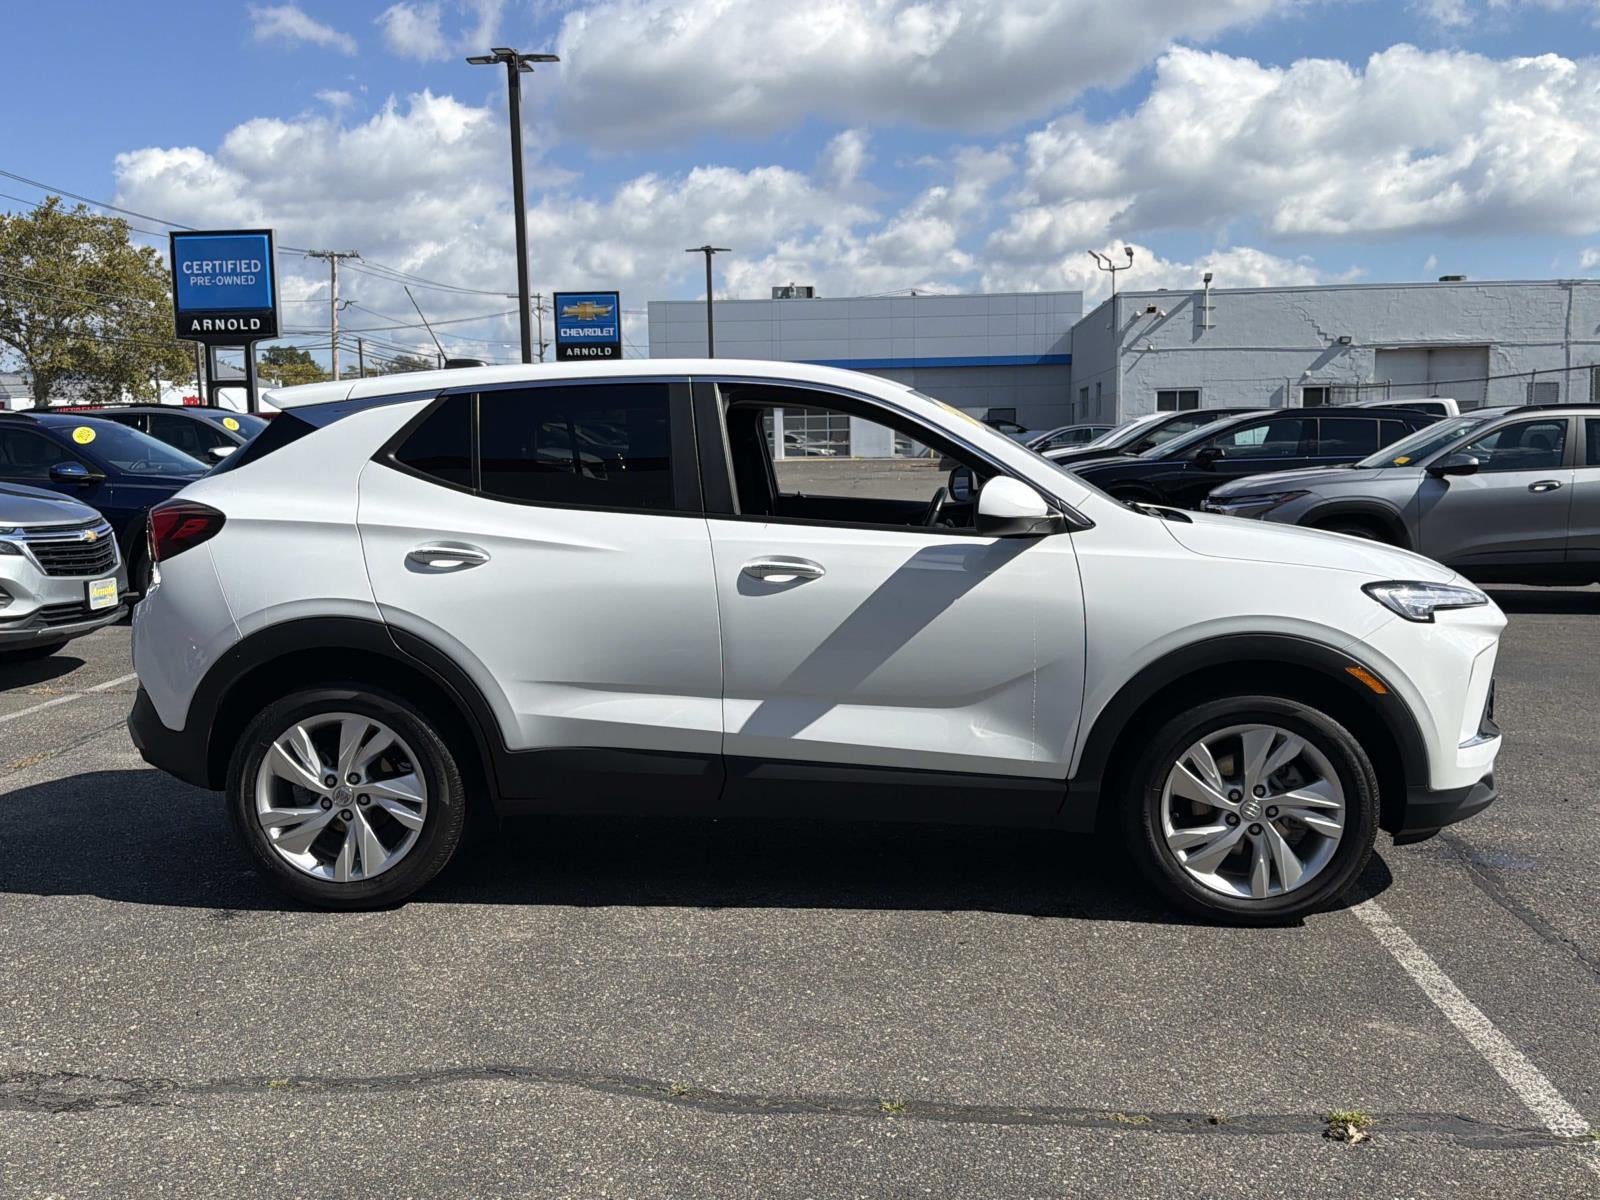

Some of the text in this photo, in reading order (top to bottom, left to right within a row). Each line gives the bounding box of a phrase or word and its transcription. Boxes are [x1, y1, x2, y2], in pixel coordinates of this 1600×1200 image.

[182, 260, 261, 274] CERTIFIED
[190, 275, 256, 287] PRE-OWNED
[191, 319, 261, 331] ARNOLD
[560, 327, 615, 337] CHEVROLET
[566, 347, 612, 356] ARNOLD
